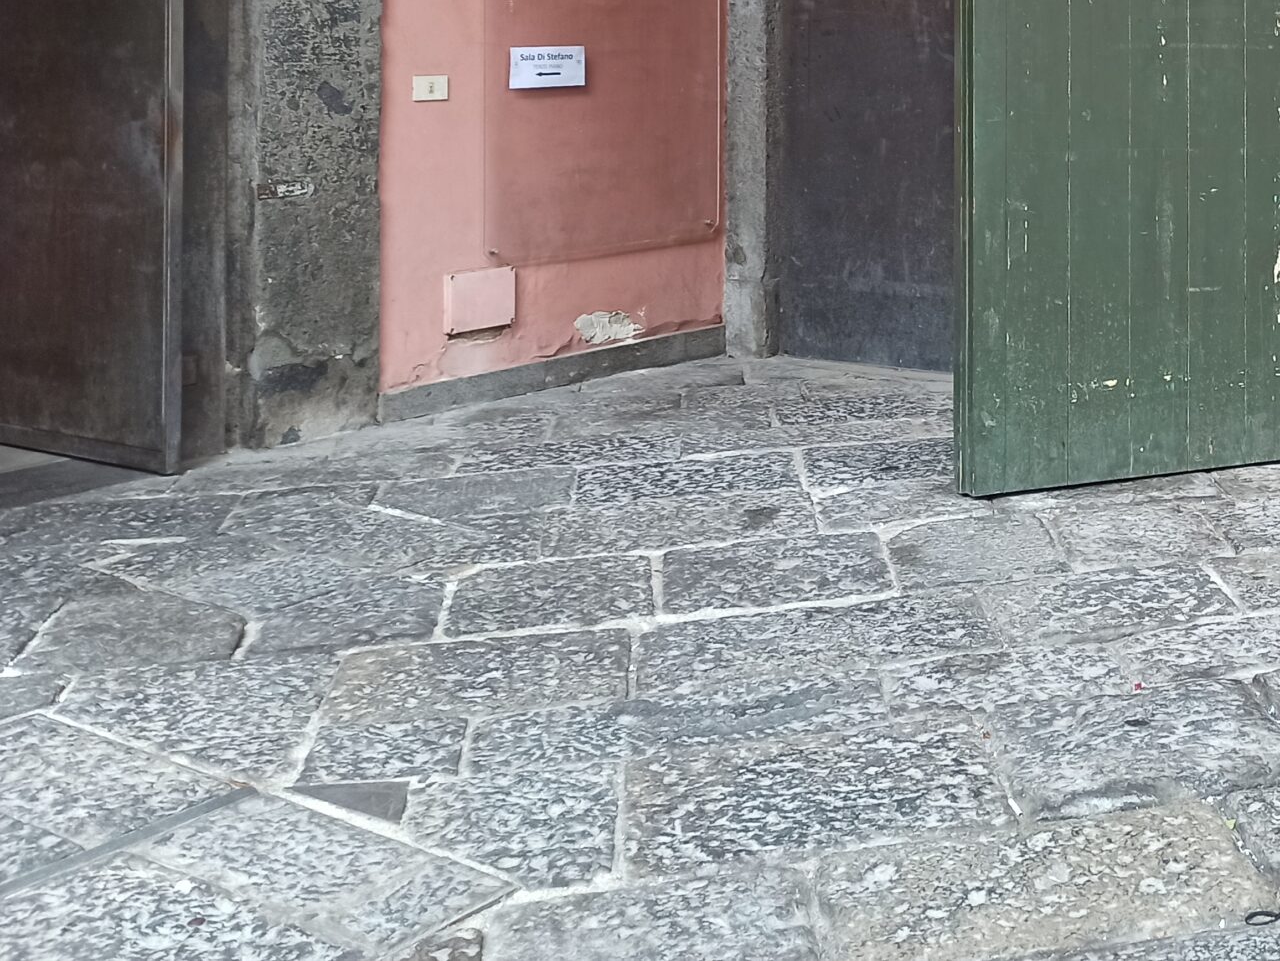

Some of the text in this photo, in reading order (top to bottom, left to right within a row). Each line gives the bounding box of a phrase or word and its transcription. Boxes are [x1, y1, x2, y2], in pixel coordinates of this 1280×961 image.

[520, 52, 573, 61] Sala Di Stefano
